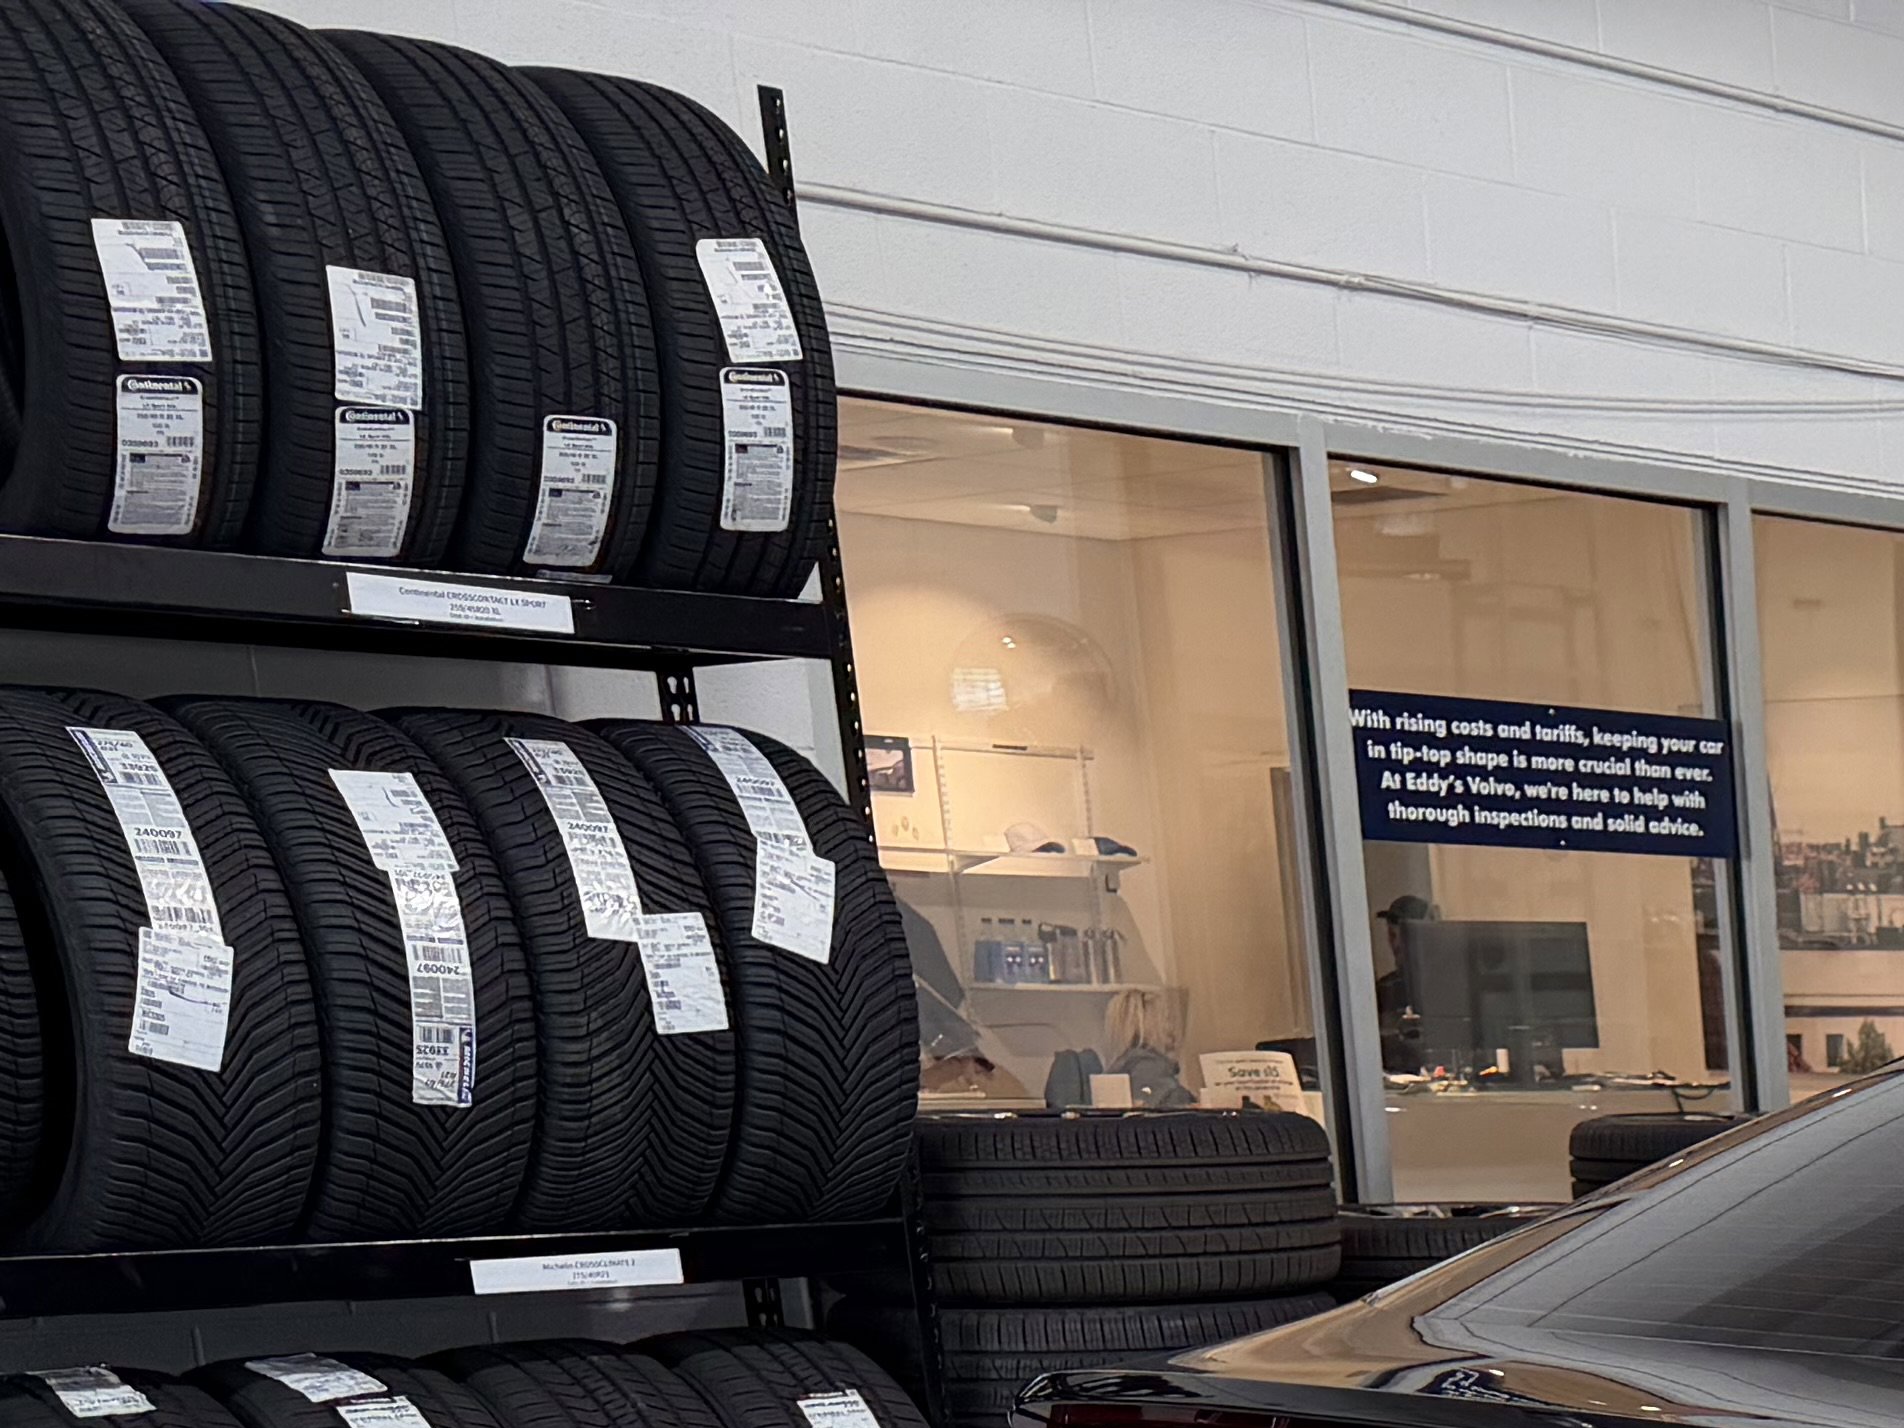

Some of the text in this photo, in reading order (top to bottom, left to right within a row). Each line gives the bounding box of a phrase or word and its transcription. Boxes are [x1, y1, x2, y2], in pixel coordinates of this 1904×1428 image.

[127, 379, 183, 391] Continental
[399, 586, 445, 599] Continental
[1348, 708, 1725, 755] With rising costs and tariffs, keeping your car
[1367, 740, 1713, 782] in tip-top shape is more crucial than ever.
[1380, 770, 1707, 811] At Eddy's Volvo, we're here to help with
[1387, 800, 1705, 837] thorough inspections and solid advice.
[133, 827, 182, 839] 240097
[1228, 1066, 1261, 1078] Save
